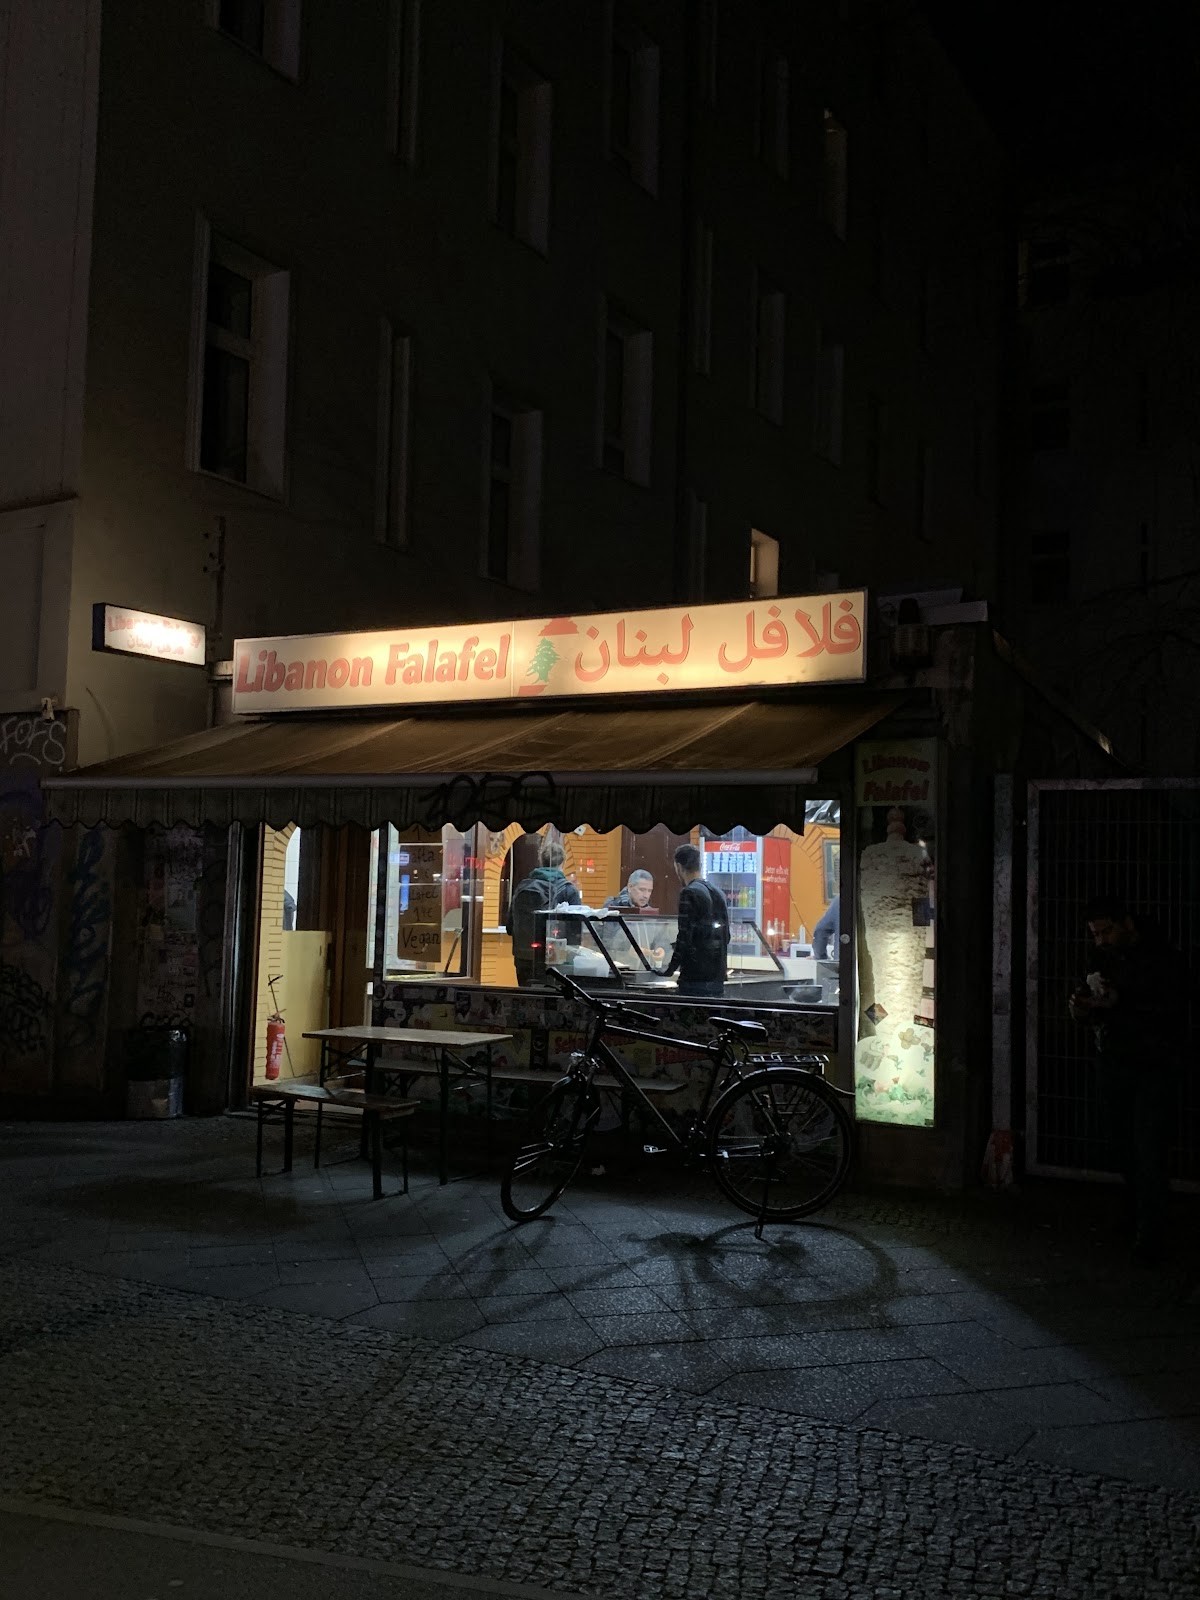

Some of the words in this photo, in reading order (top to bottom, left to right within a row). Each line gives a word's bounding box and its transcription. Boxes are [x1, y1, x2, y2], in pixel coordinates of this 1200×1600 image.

[574, 613, 695, 685] لبنان
[717, 599, 861, 673] فلافل
[235, 649, 373, 694] Libanon
[385, 634, 510, 686] Falafel
[862, 754, 929, 774] Libanon
[863, 778, 929, 801] Falafel
[402, 927, 441, 954] Vegan
